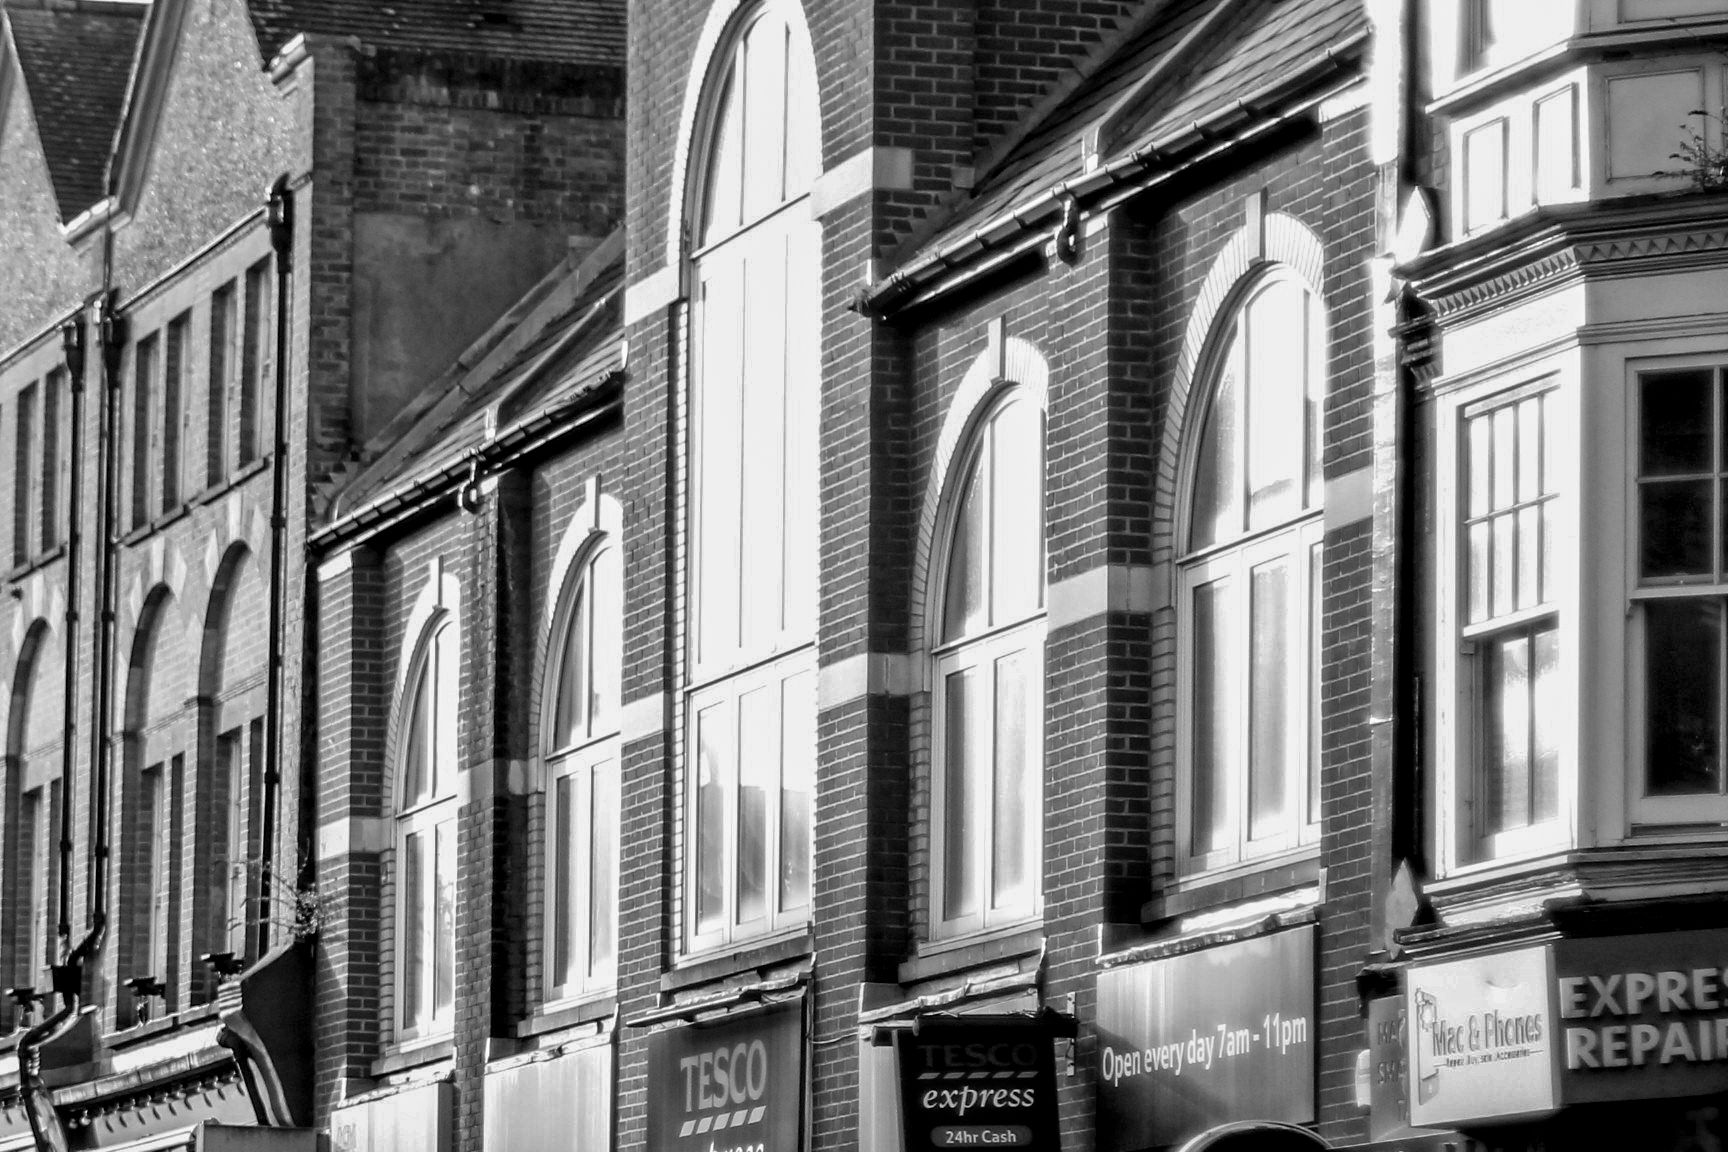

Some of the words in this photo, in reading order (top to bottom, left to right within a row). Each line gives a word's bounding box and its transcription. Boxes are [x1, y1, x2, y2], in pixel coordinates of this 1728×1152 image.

[1559, 967, 1728, 1019] EXPRE
[916, 1043, 1038, 1068] TESCO
[1102, 1046, 1141, 1088] Open
[1144, 1041, 1185, 1076] every
[1187, 1028, 1215, 1071] day
[1217, 1023, 1250, 1059] 7am
[1263, 1012, 1307, 1055] 11pm
[1432, 1020, 1464, 1057] Mac
[1484, 1009, 1543, 1049] Phones
[680, 1039, 767, 1113] TESCO
[922, 1085, 1035, 1117] express
[945, 1130, 979, 1144] 24hr
[981, 1129, 1017, 1144] Cash
